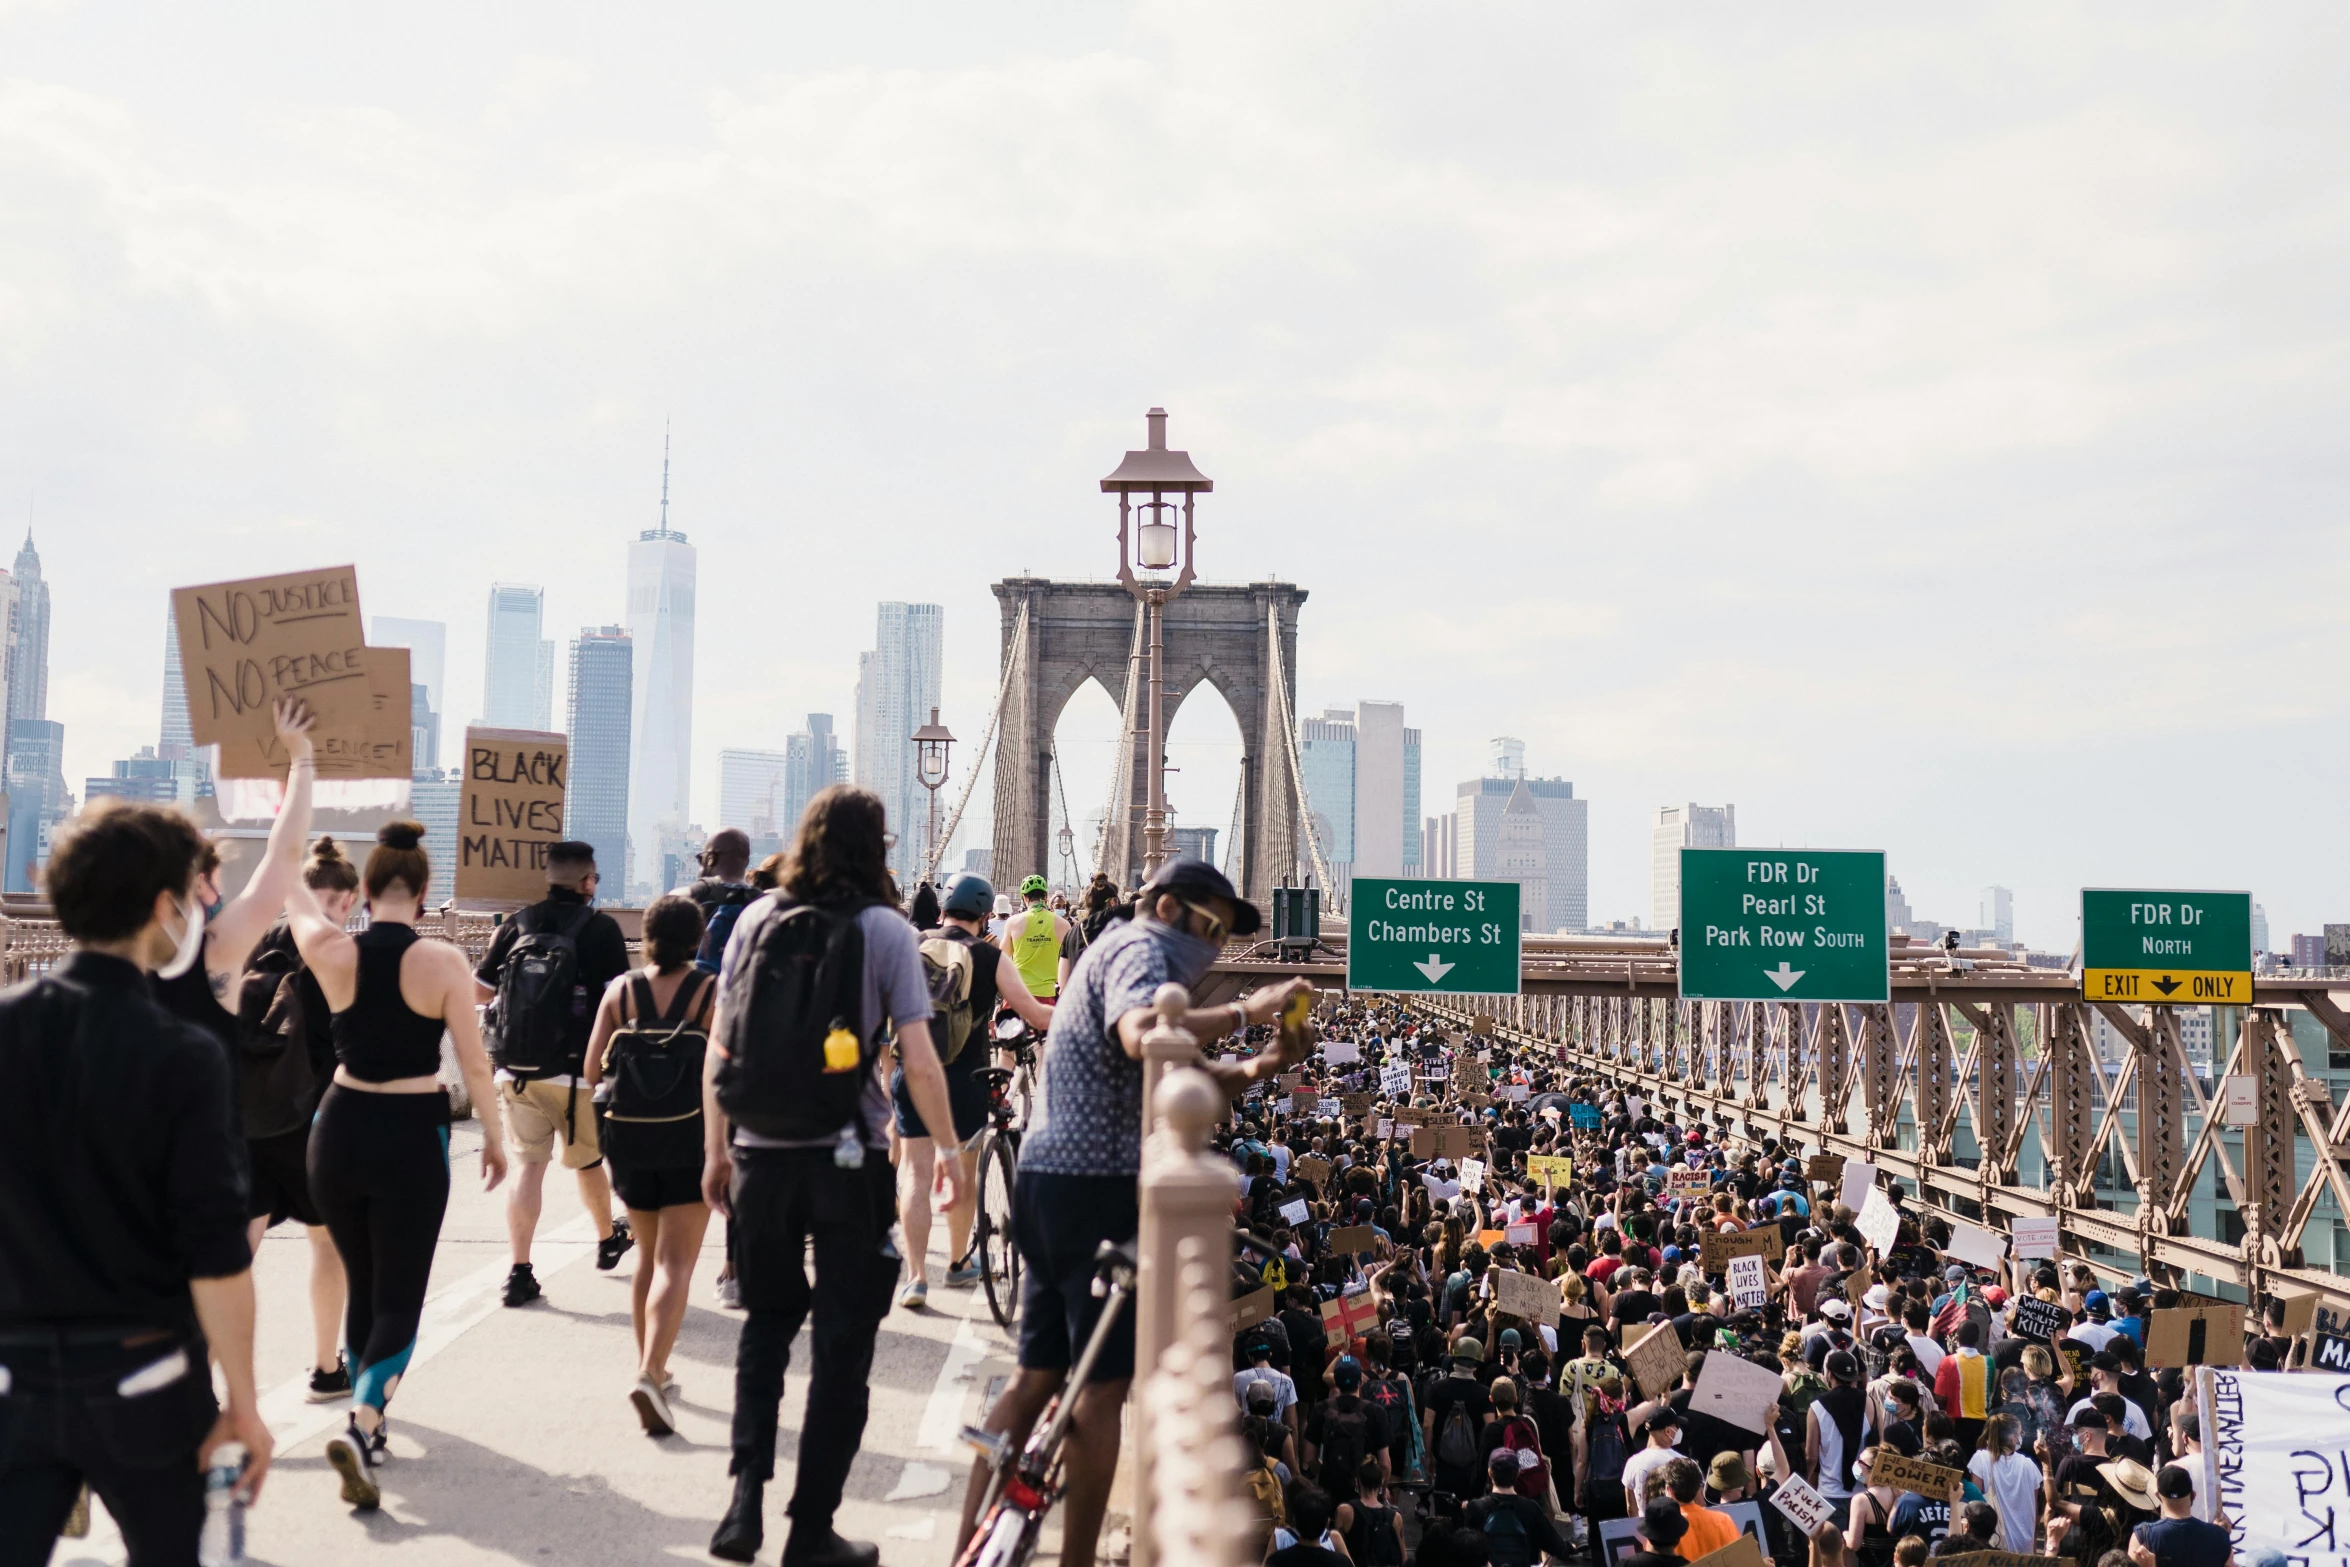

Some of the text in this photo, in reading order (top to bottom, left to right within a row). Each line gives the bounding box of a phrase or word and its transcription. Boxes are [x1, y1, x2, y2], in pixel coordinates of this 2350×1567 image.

[197, 578, 351, 650] NO JUSTICE
[205, 647, 360, 719] NO PEACE
[256, 738, 401, 759] VENCE!
[472, 748, 565, 790] BLACK
[471, 794, 561, 833] LIVES
[463, 835, 551, 871] MATTE
[1747, 862, 1819, 883] FDR Dr
[1385, 888, 1485, 912] Centre St
[1743, 894, 1826, 916] Pearl St
[2131, 903, 2203, 925] FDR Dr
[1368, 920, 1501, 944] Chambers St
[1706, 925, 1865, 948] Park Row SOUTH
[2143, 936, 2192, 955] NORTH
[2105, 975, 2234, 997] EXIT ONLY
[1383, 1070, 1408, 1082] CHANGED
[1460, 1063, 1483, 1075] BLACK
[1387, 1083, 1408, 1095] WORLD
[1390, 1079, 1403, 1087] THE
[1429, 1116, 1454, 1124] SILENCE
[1384, 1128, 1409, 1136] MTER
[1533, 1174, 1567, 1185] WOEN
[1672, 1172, 1707, 1181] RACISM
[1725, 1247, 1737, 1256] IS
[1733, 1260, 1757, 1274] BLACK
[1735, 1274, 1759, 1288] LIVES
[1736, 1289, 1767, 1307] MATTER
[2023, 1295, 2061, 1318] WHITE
[2016, 1305, 2061, 1328] FRAGILITY
[2017, 1316, 2054, 1340] KILLS
[1630, 1326, 1678, 1373] SILENCE
[1654, 1356, 1667, 1370] NOT
[1706, 1362, 1750, 1373] COVID
[1648, 1357, 1689, 1395] OPTION
[1716, 1376, 1770, 1387] DEATHS
[1734, 1392, 1773, 1403] STATE
[1702, 1404, 1765, 1416] VIOLENC
[1880, 1463, 1947, 1488] POWER
[1884, 1455, 1955, 1478] WE ARE THE
[1873, 1475, 1950, 1500] BLACK LIVES MATTE
[1793, 1486, 1824, 1512] fuck
[1777, 1491, 1818, 1530] RACISM
[1919, 1506, 1950, 1524] JETE
